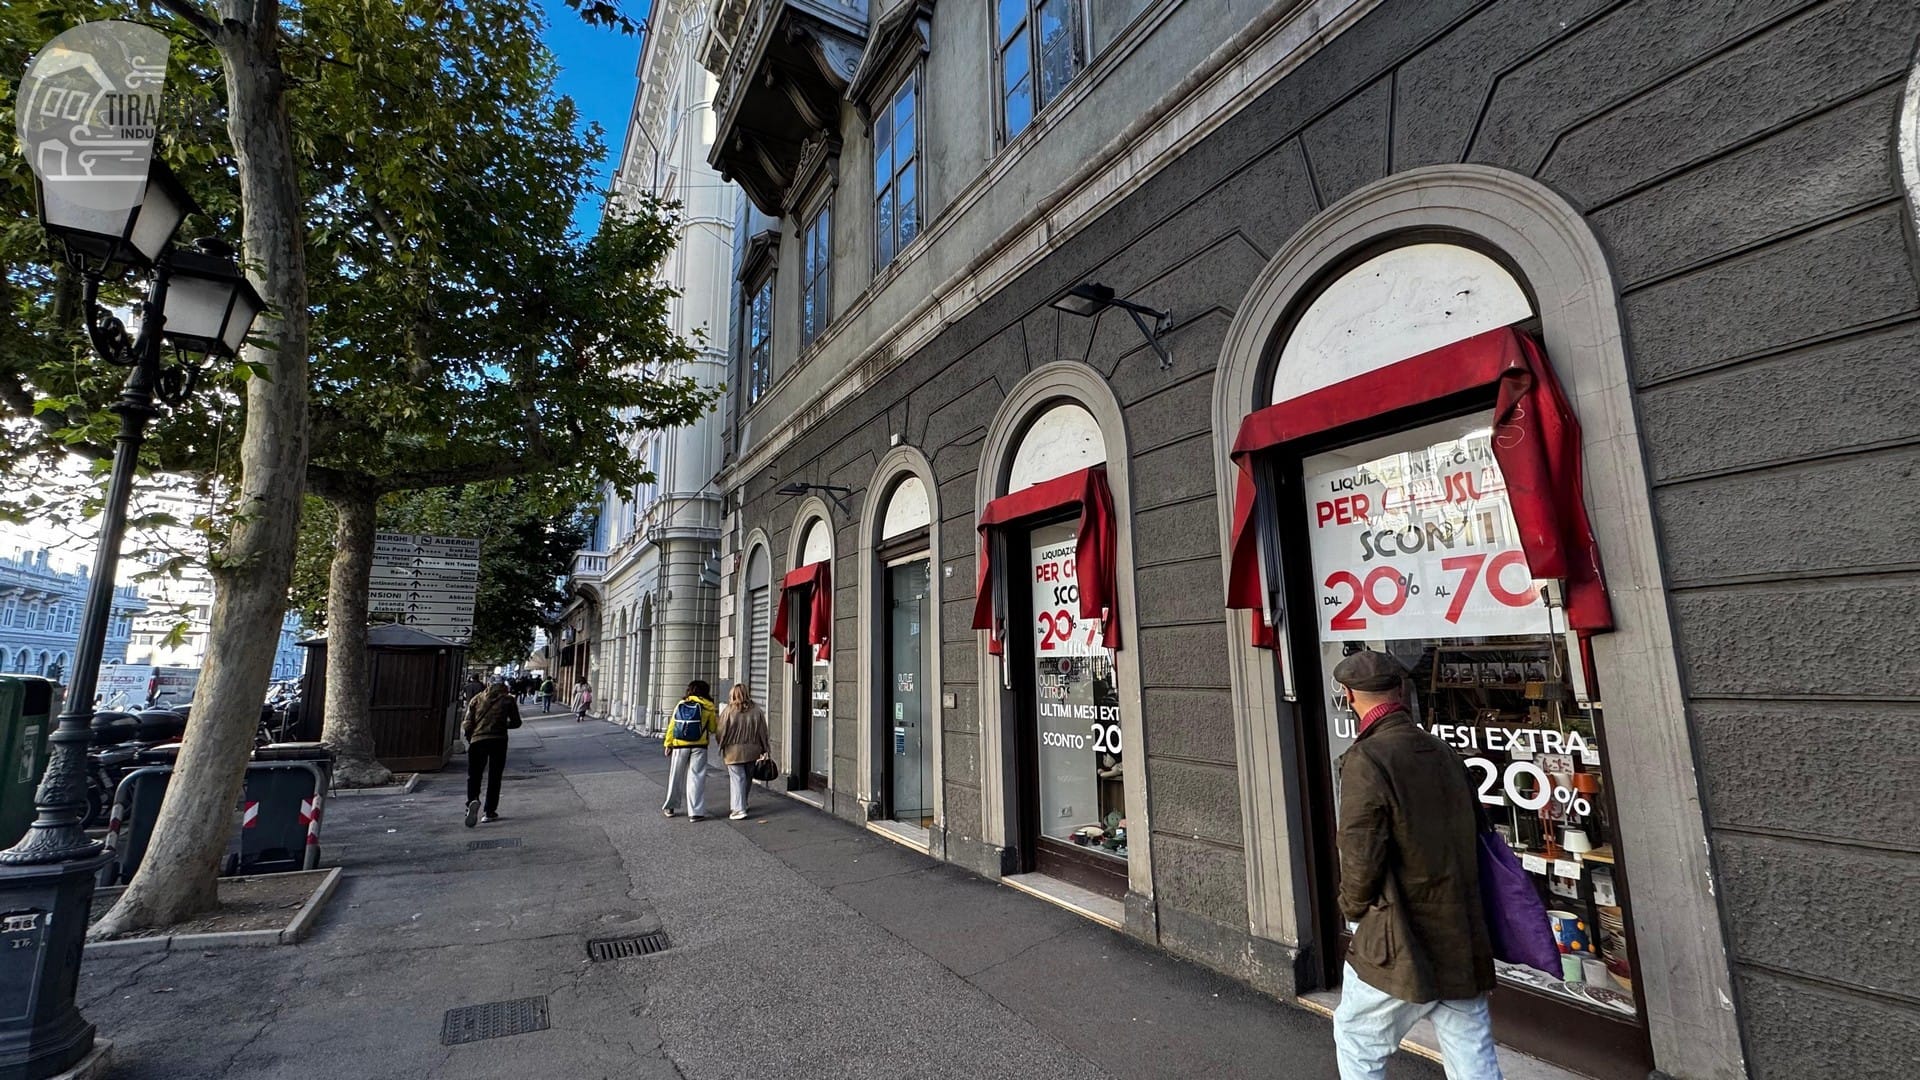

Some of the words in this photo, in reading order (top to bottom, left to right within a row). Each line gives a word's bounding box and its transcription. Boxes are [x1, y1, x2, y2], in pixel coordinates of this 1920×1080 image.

[1316, 494, 1370, 528] PER
[434, 538, 475, 546] ALBERGHI
[1360, 512, 1496, 561] SCONTI
[1036, 562, 1060, 583] PER
[1053, 585, 1079, 606] SCO
[1435, 585, 1450, 597] AL
[1441, 550, 1541, 624] 70
[1324, 565, 1420, 631] 20%
[1324, 596, 1342, 606] DAL
[1039, 674, 1067, 686] OUTLET
[1039, 687, 1068, 699] VITRUM
[1040, 703, 1071, 718] ULTIMI
[1074, 704, 1097, 719] MESI
[1100, 706, 1119, 721] EXT
[1043, 731, 1084, 749] SCONTO
[1486, 726, 1589, 755] EXTRA
[1463, 757, 1591, 816] 20%
